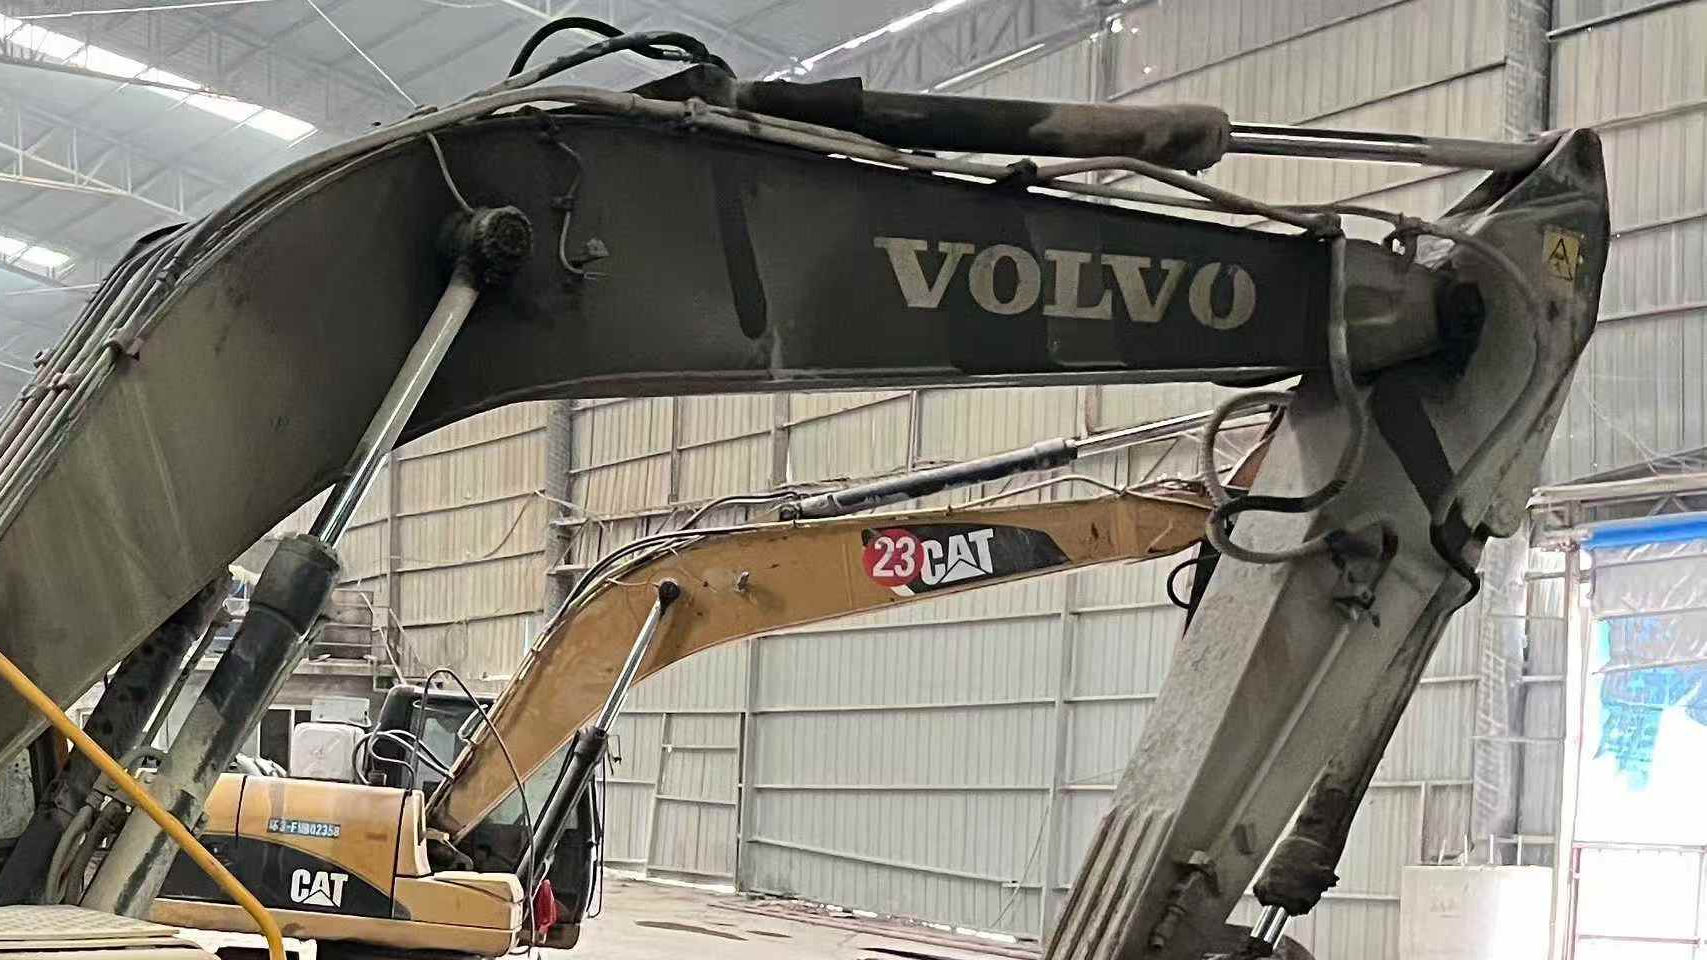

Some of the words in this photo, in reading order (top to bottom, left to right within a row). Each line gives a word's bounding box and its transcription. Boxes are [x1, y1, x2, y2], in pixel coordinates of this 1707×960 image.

[874, 237, 1256, 330] VOLVO
[873, 536, 917, 578] 23
[921, 528, 993, 586] CAT
[290, 868, 349, 907] CAT
